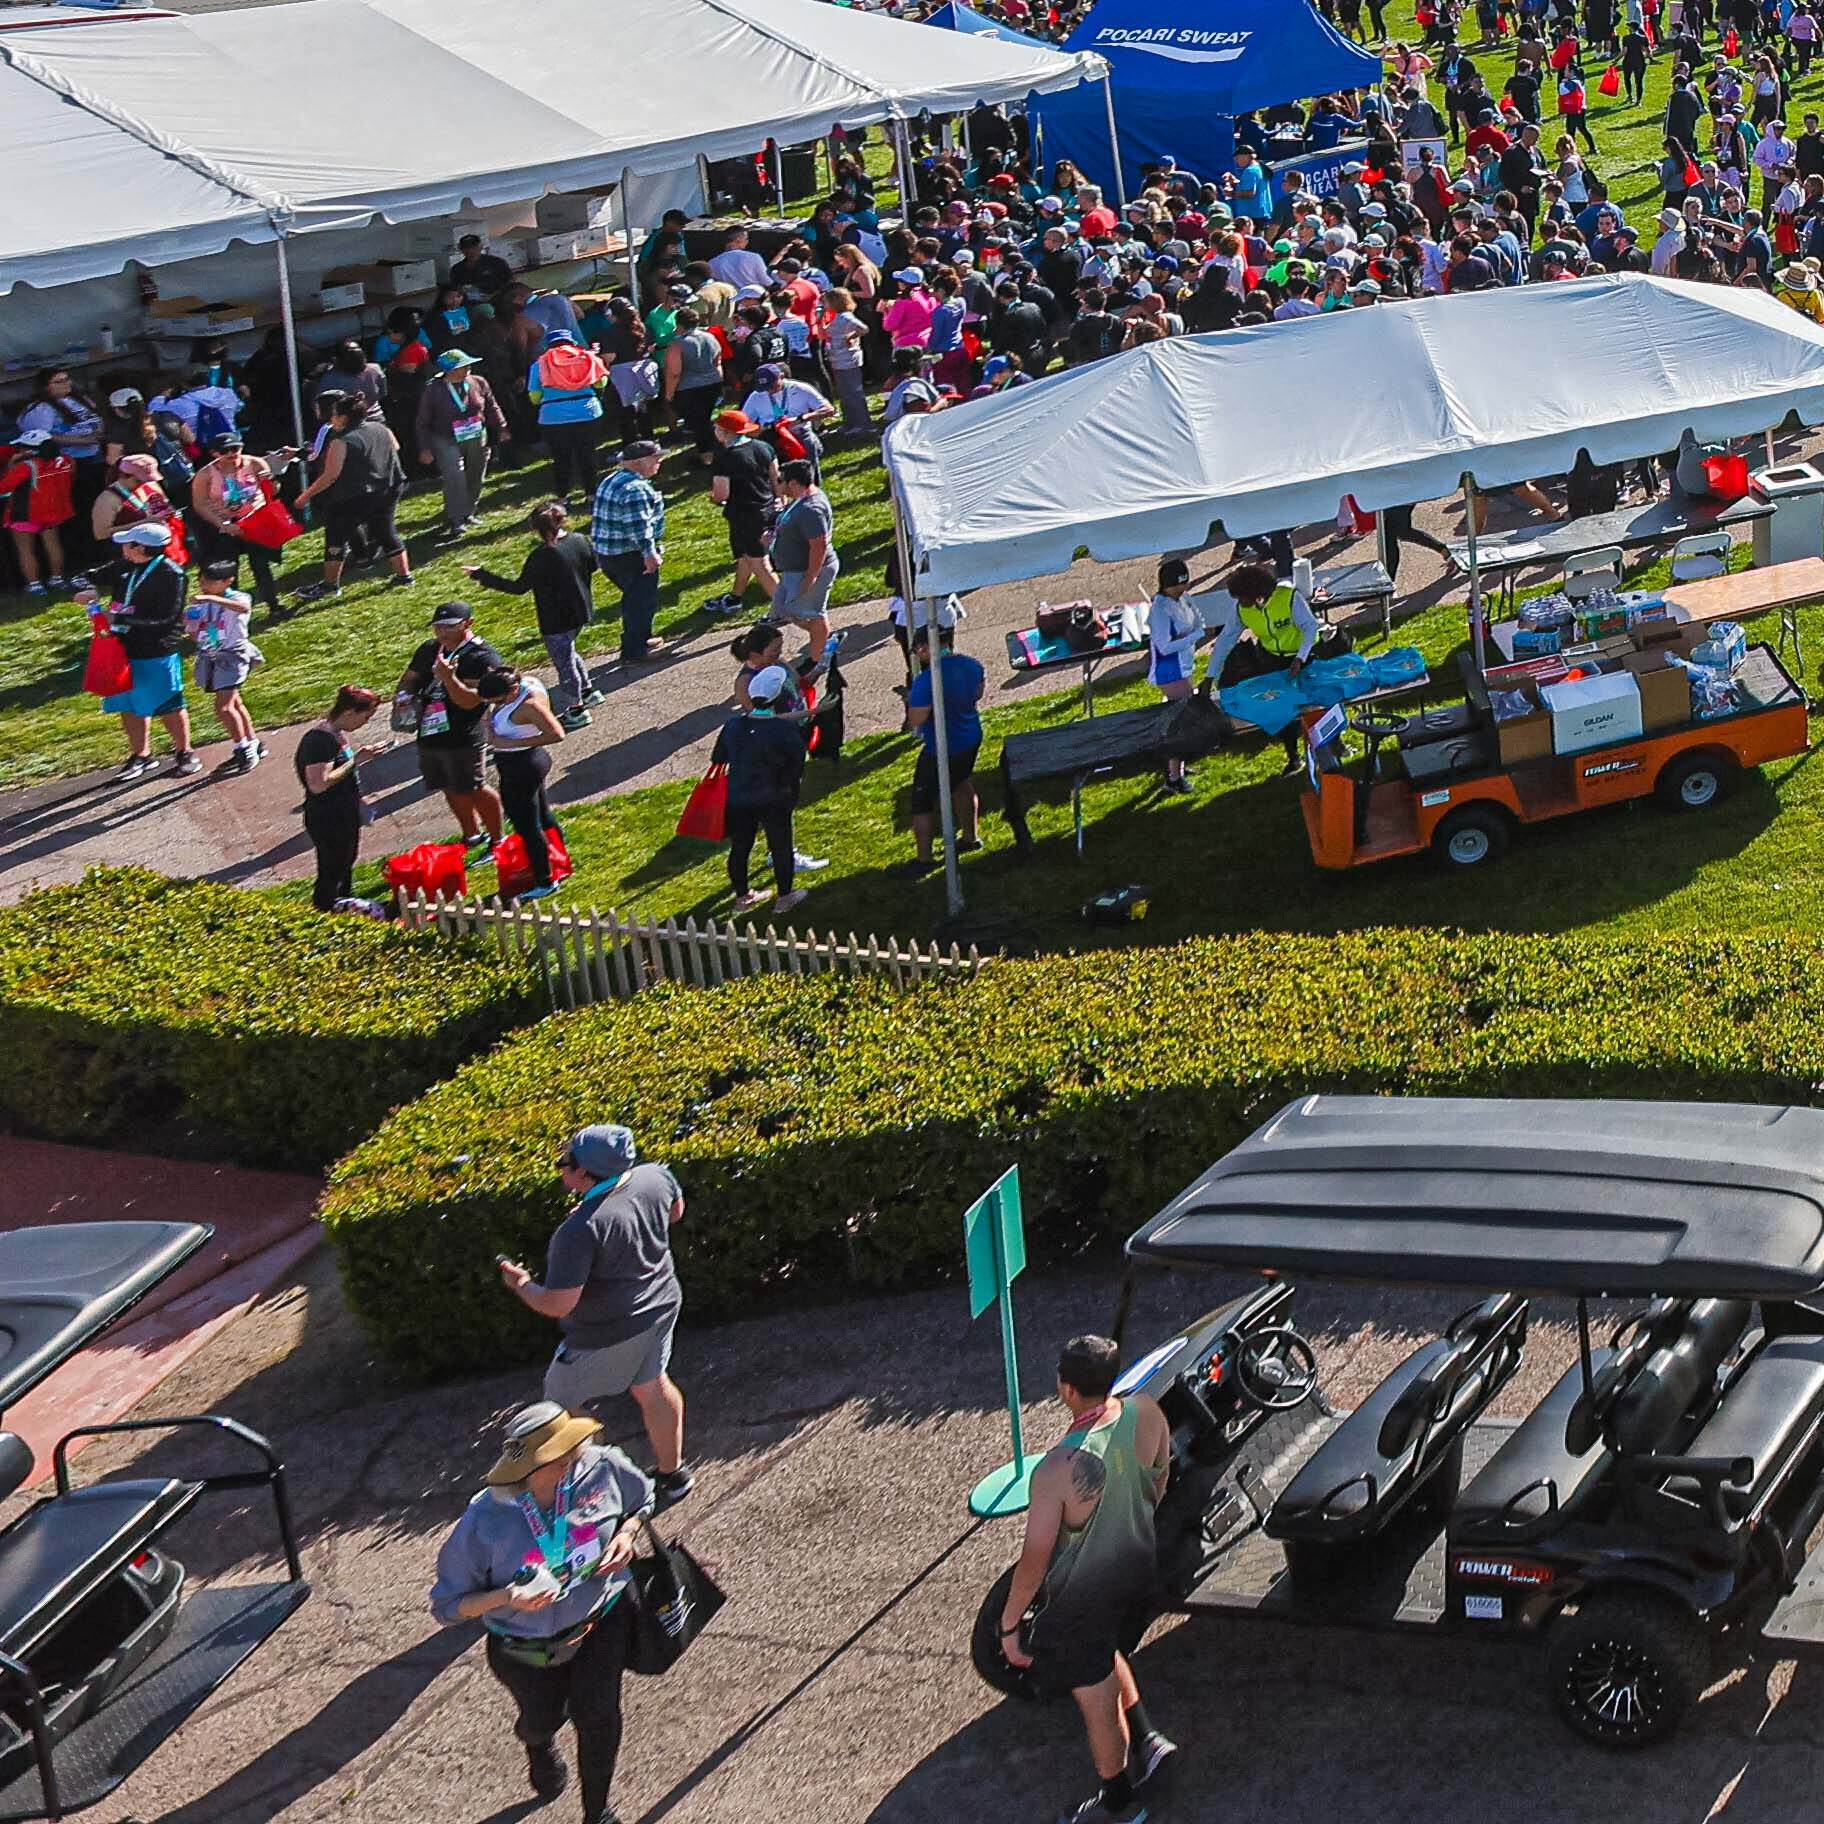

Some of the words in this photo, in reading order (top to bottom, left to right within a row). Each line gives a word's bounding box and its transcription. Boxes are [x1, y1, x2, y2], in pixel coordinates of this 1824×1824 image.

[1095, 28, 1175, 42] POCARI
[1177, 29, 1254, 45] SWEAT
[1583, 713, 1614, 727] GILDAN
